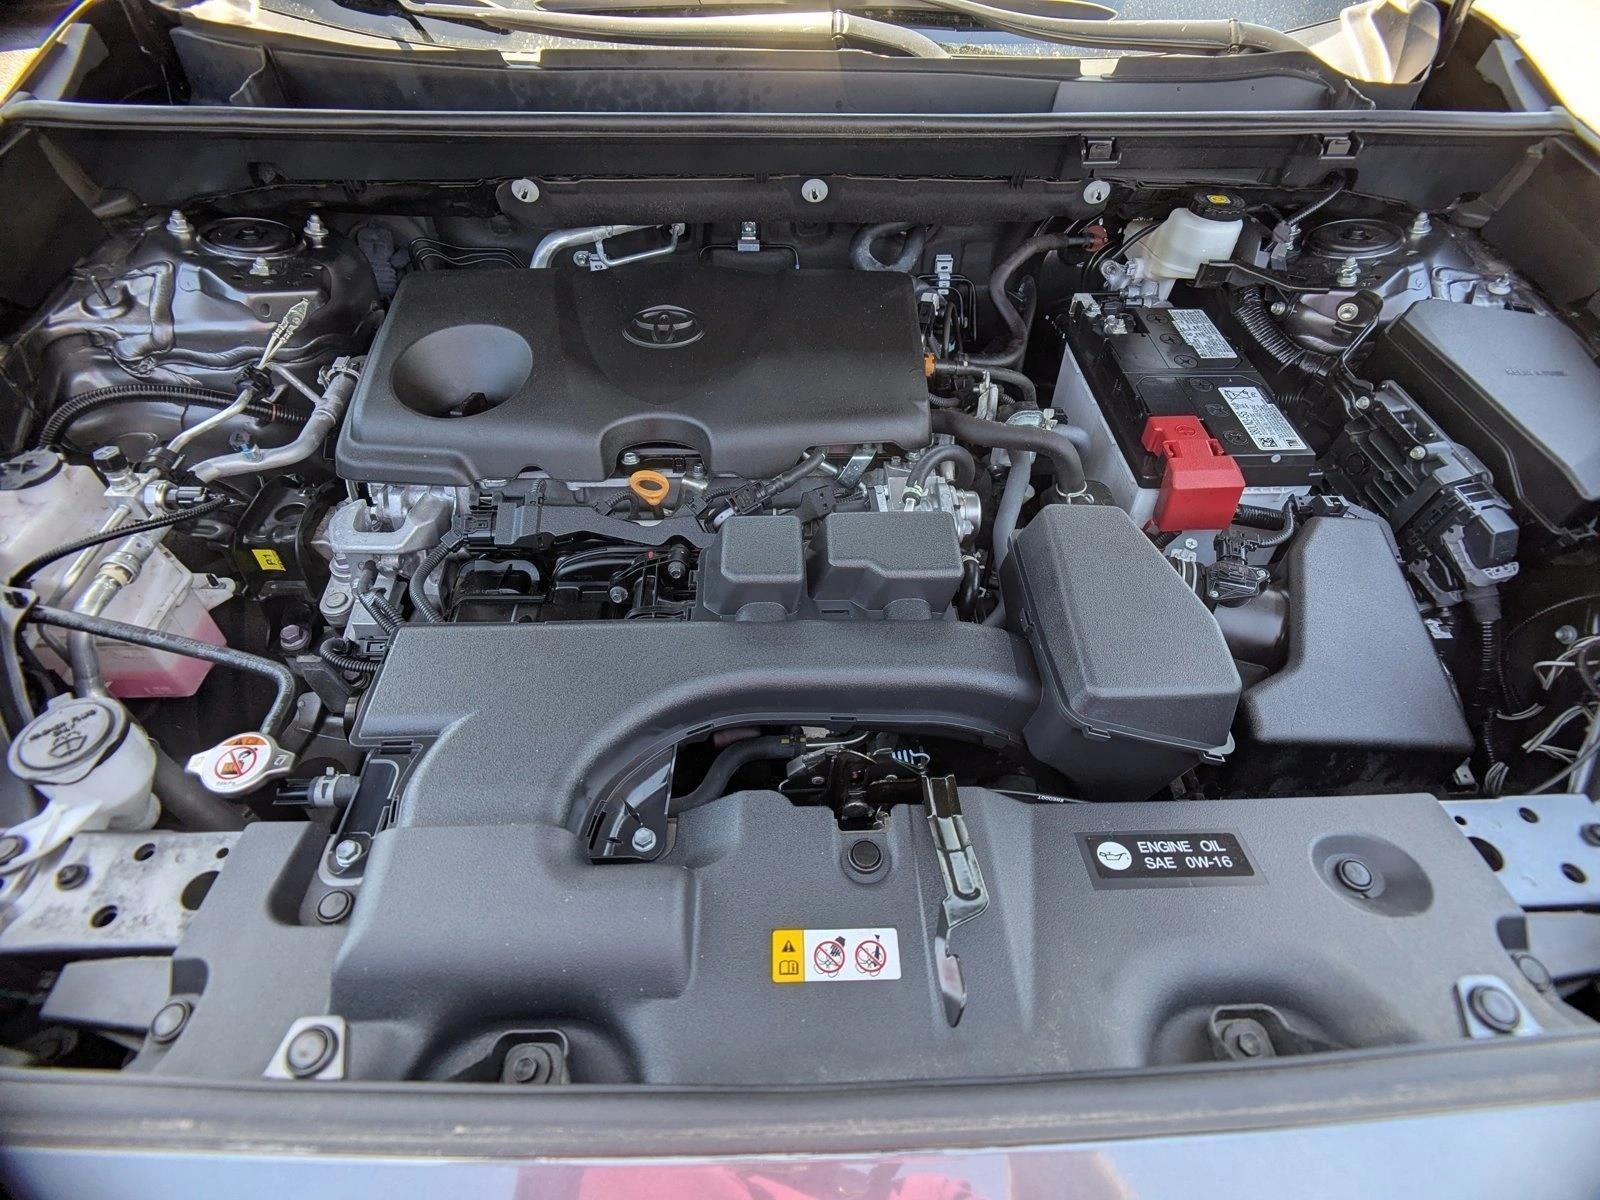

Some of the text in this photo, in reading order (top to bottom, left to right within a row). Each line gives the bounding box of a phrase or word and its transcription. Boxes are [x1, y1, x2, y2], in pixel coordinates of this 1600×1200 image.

[1137, 839, 1227, 854] ENGINE OIL
[1144, 855, 1234, 870] SAE 0W-16
